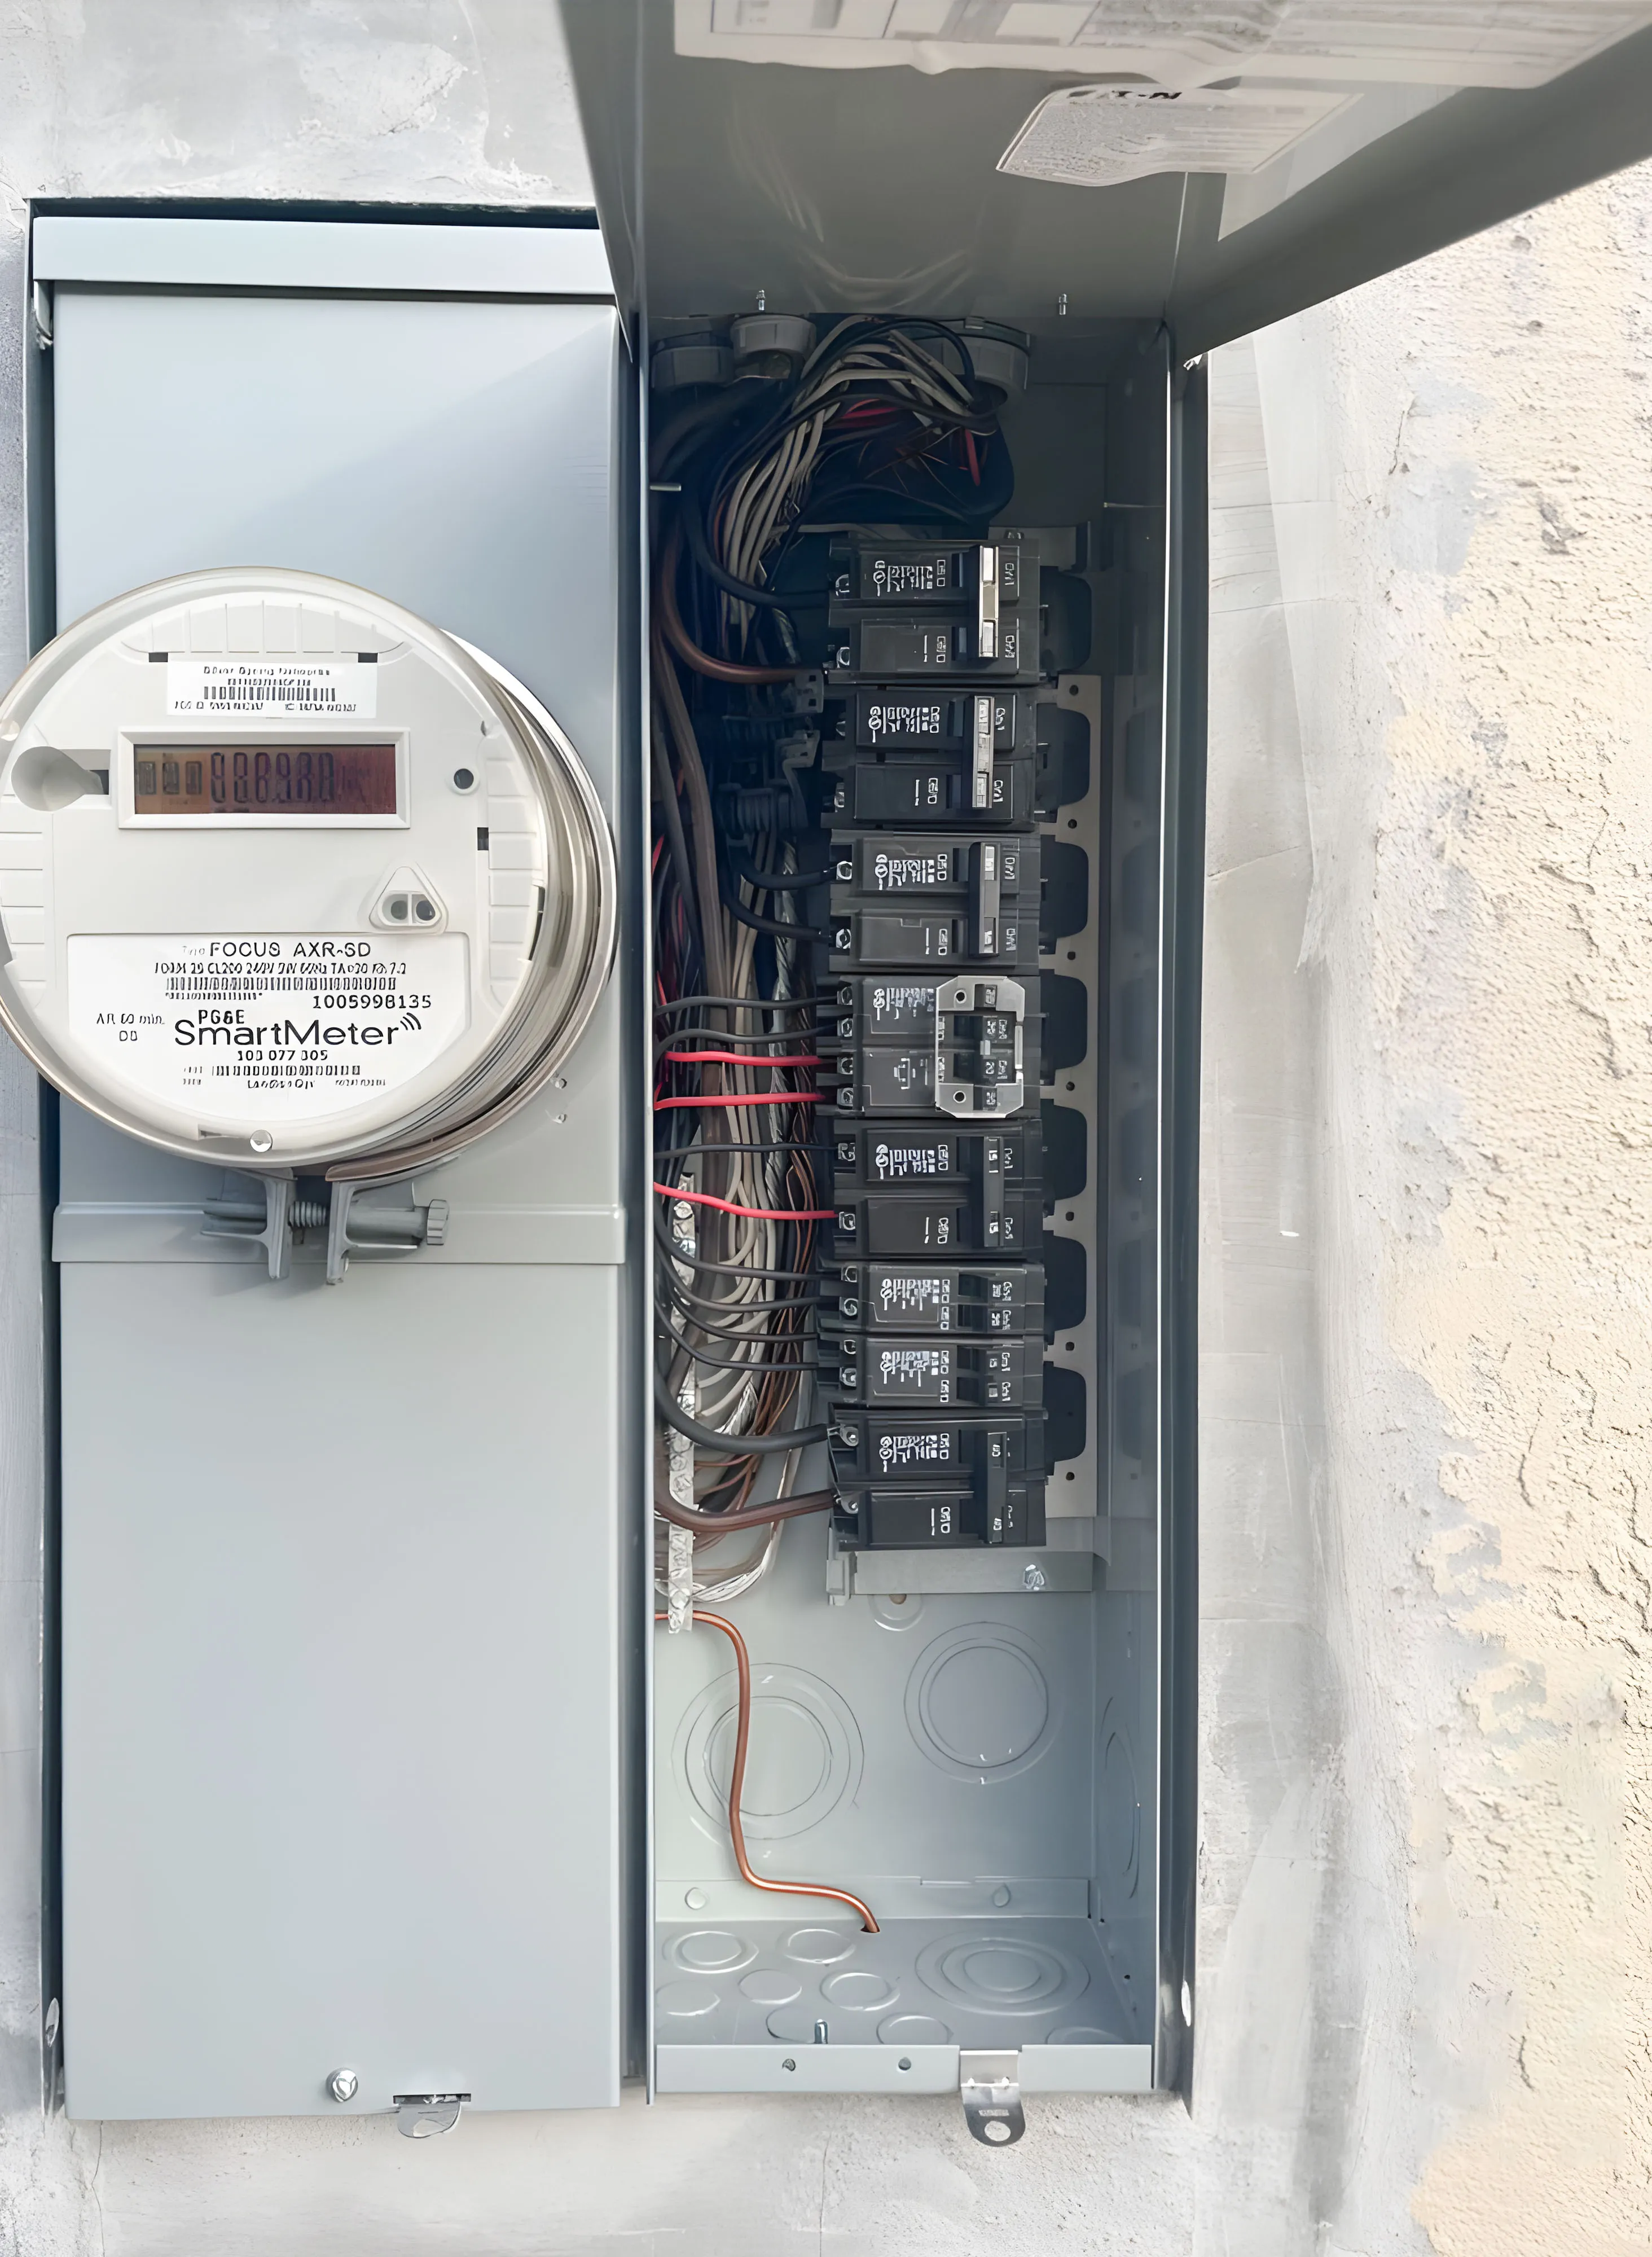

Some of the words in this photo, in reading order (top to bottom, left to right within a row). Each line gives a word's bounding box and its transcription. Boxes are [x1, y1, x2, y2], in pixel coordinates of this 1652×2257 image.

[210, 942, 280, 958] FOCUS
[293, 942, 371, 958] AXR-SD
[313, 995, 432, 1009] 1005998135
[198, 1009, 245, 1025] PG&E
[174, 1018, 399, 1046] SmartMeter
